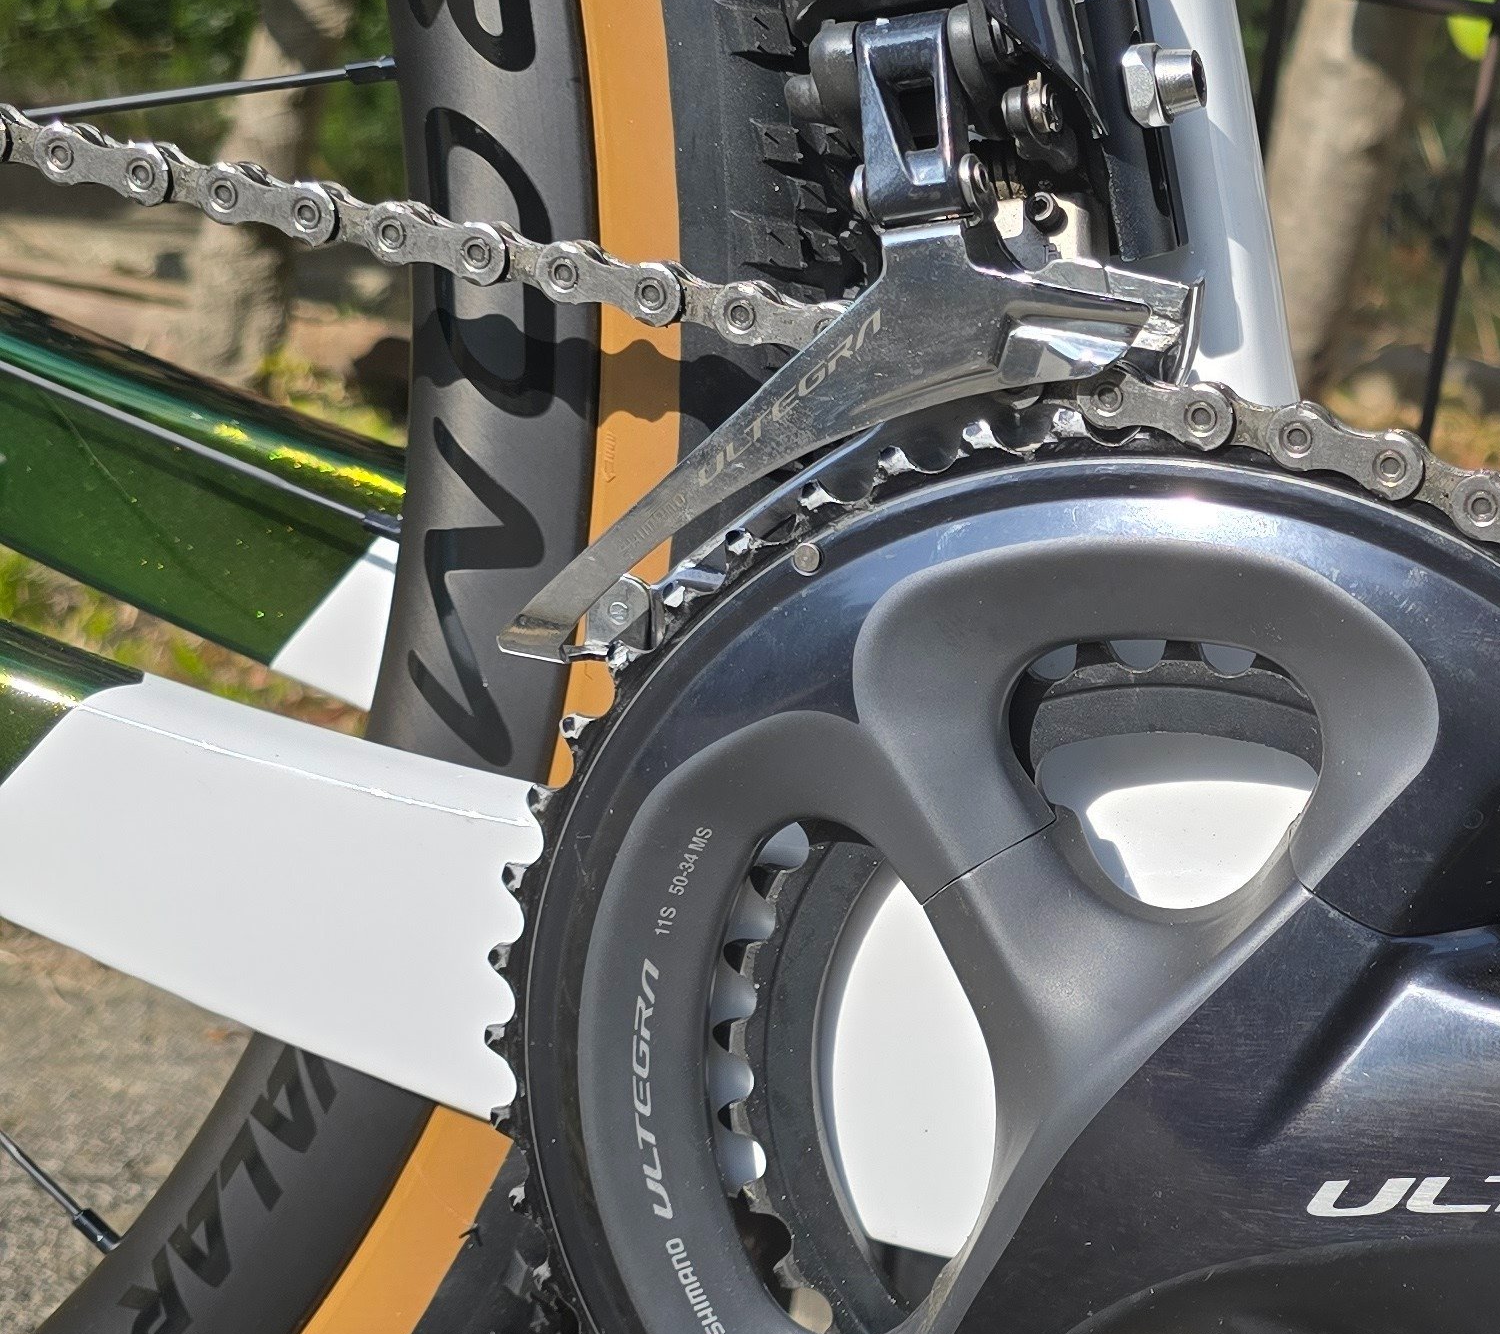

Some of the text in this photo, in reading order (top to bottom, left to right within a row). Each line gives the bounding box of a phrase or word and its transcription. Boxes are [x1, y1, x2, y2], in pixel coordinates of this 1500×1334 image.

[698, 308, 881, 487] ULTEGRA
[632, 958, 674, 1220] ULTEGRA
[654, 906, 677, 936] 11S
[668, 853, 699, 896] 50-34
[688, 827, 713, 852] MS
